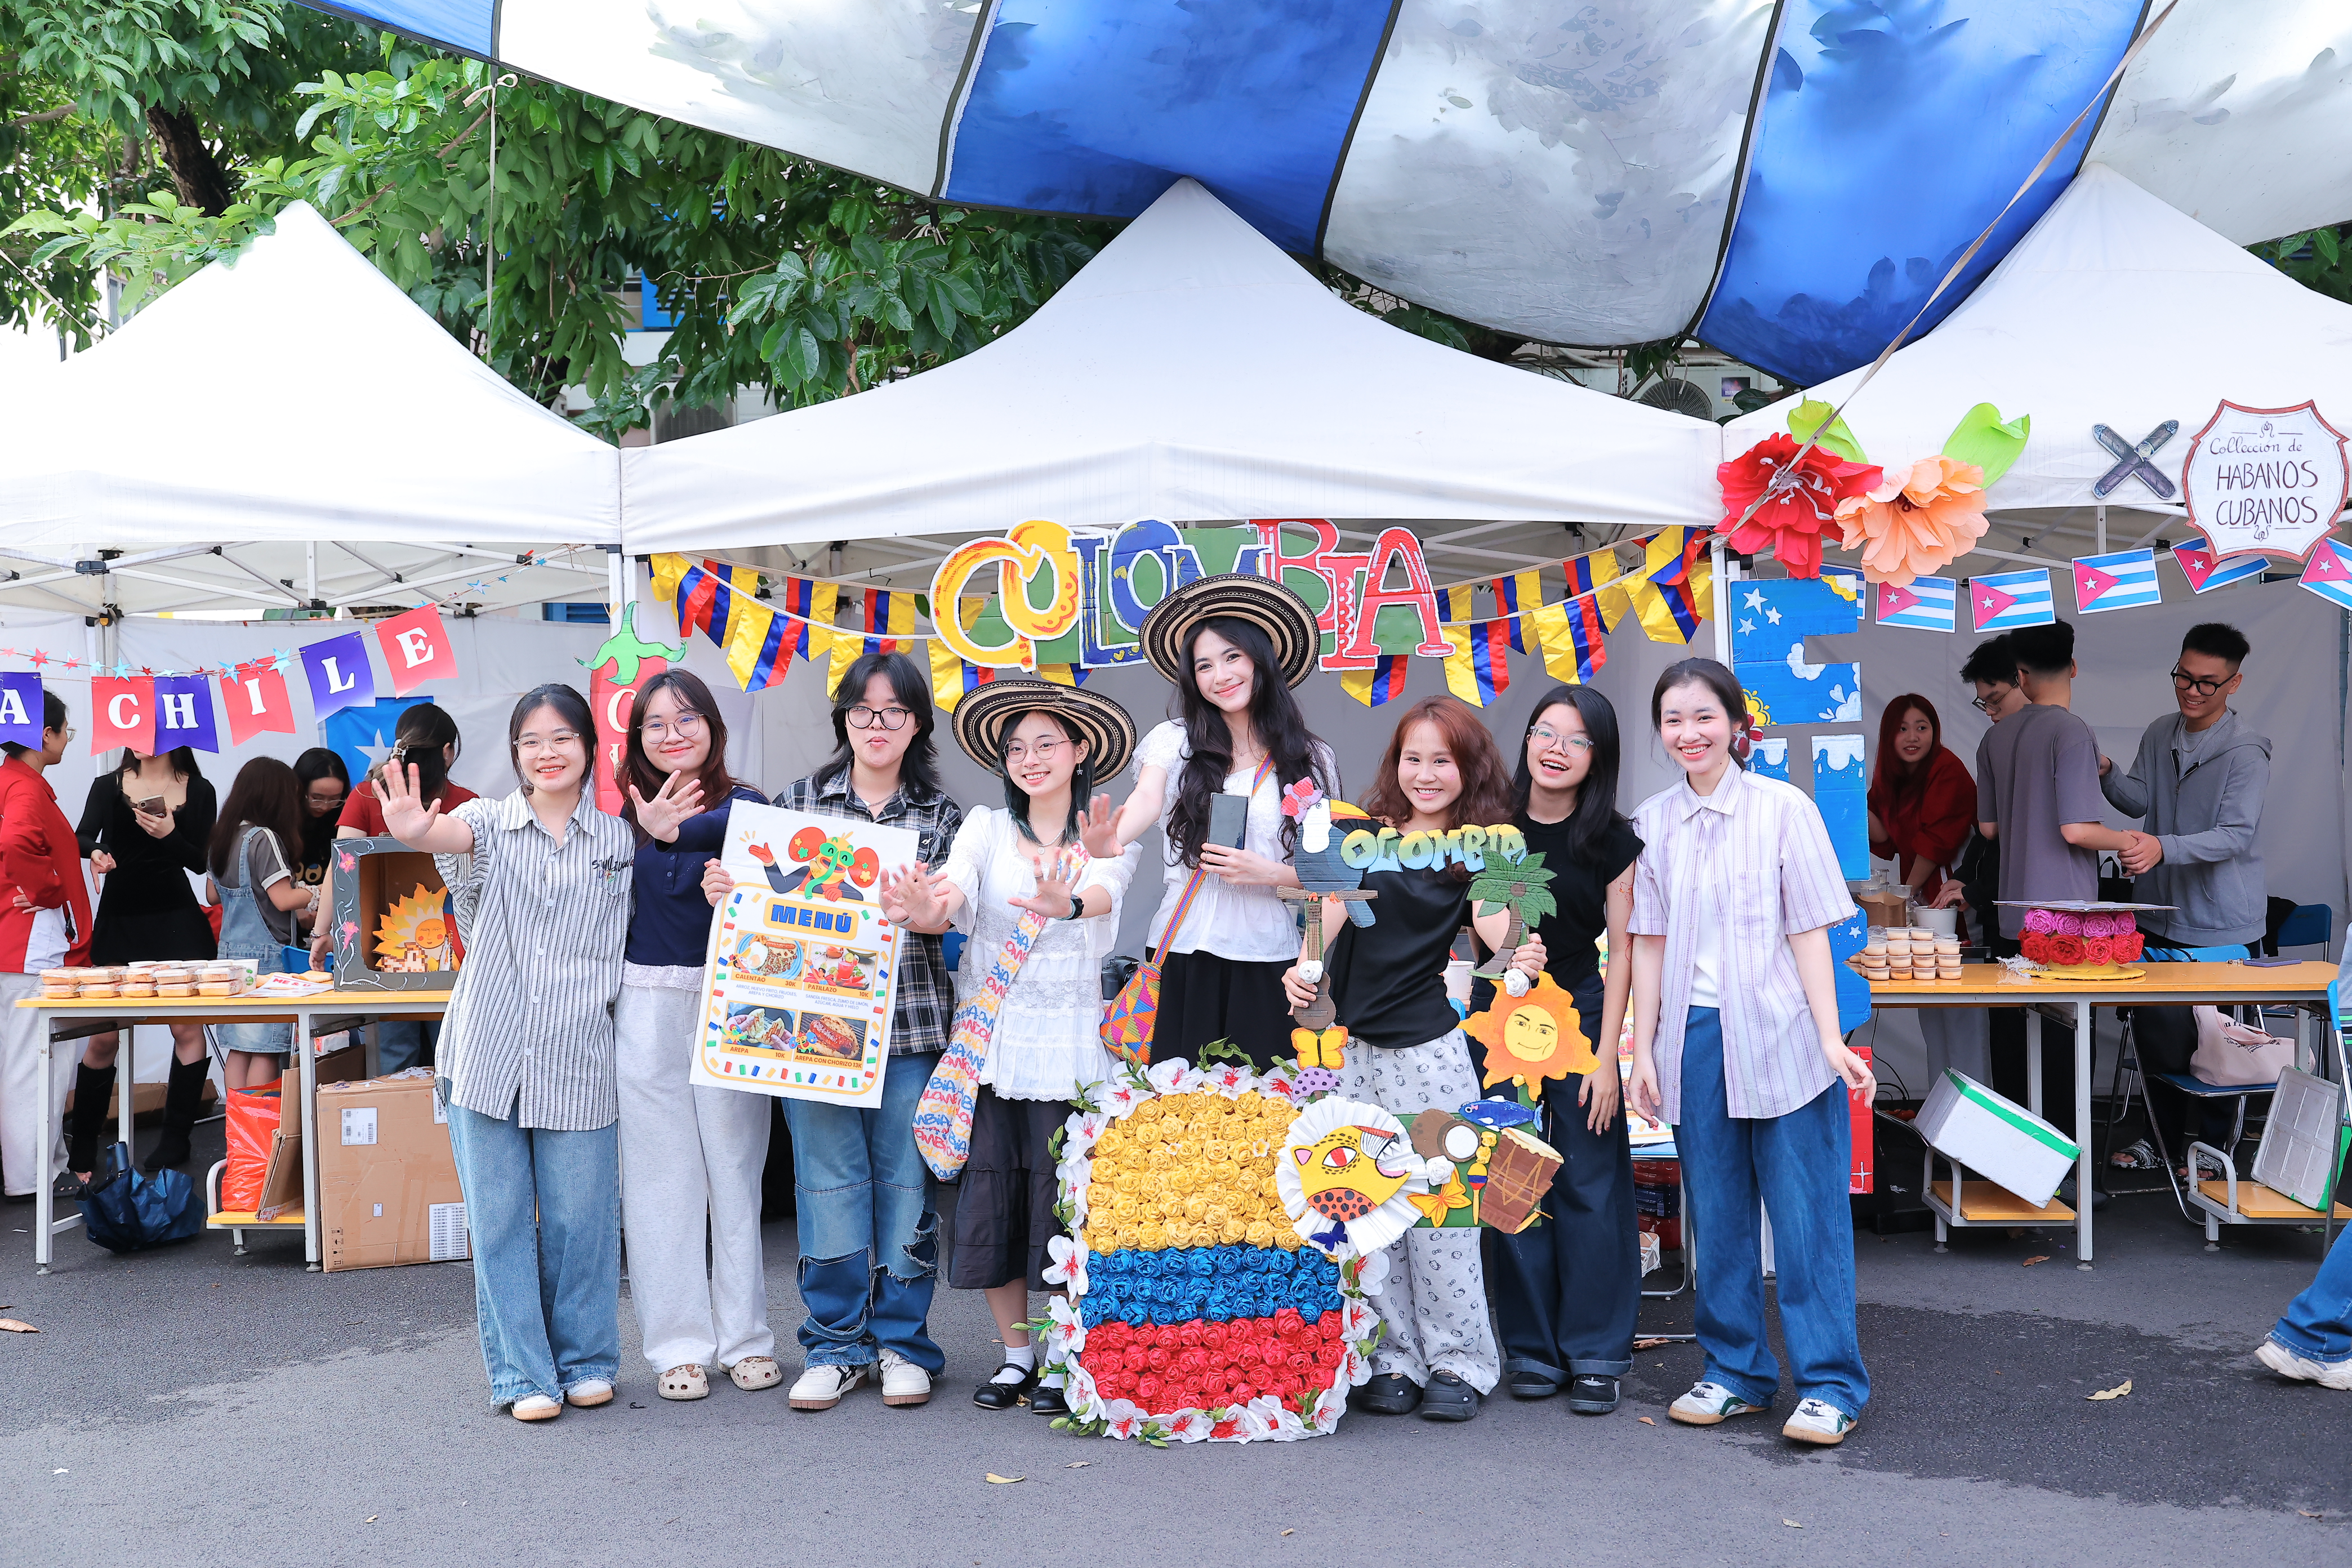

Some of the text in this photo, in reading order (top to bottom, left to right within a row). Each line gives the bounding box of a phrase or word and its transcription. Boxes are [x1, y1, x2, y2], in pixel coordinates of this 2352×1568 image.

[2288, 438, 2302, 452] de
[2217, 460, 2318, 491] HABANOS
[2216, 496, 2318, 526] CUBANOS
[108, 627, 434, 729] CHILE
[770, 904, 852, 933] MENÚ
[736, 973, 766, 982] CALENTAO
[808, 984, 837, 992] PATILLAZO
